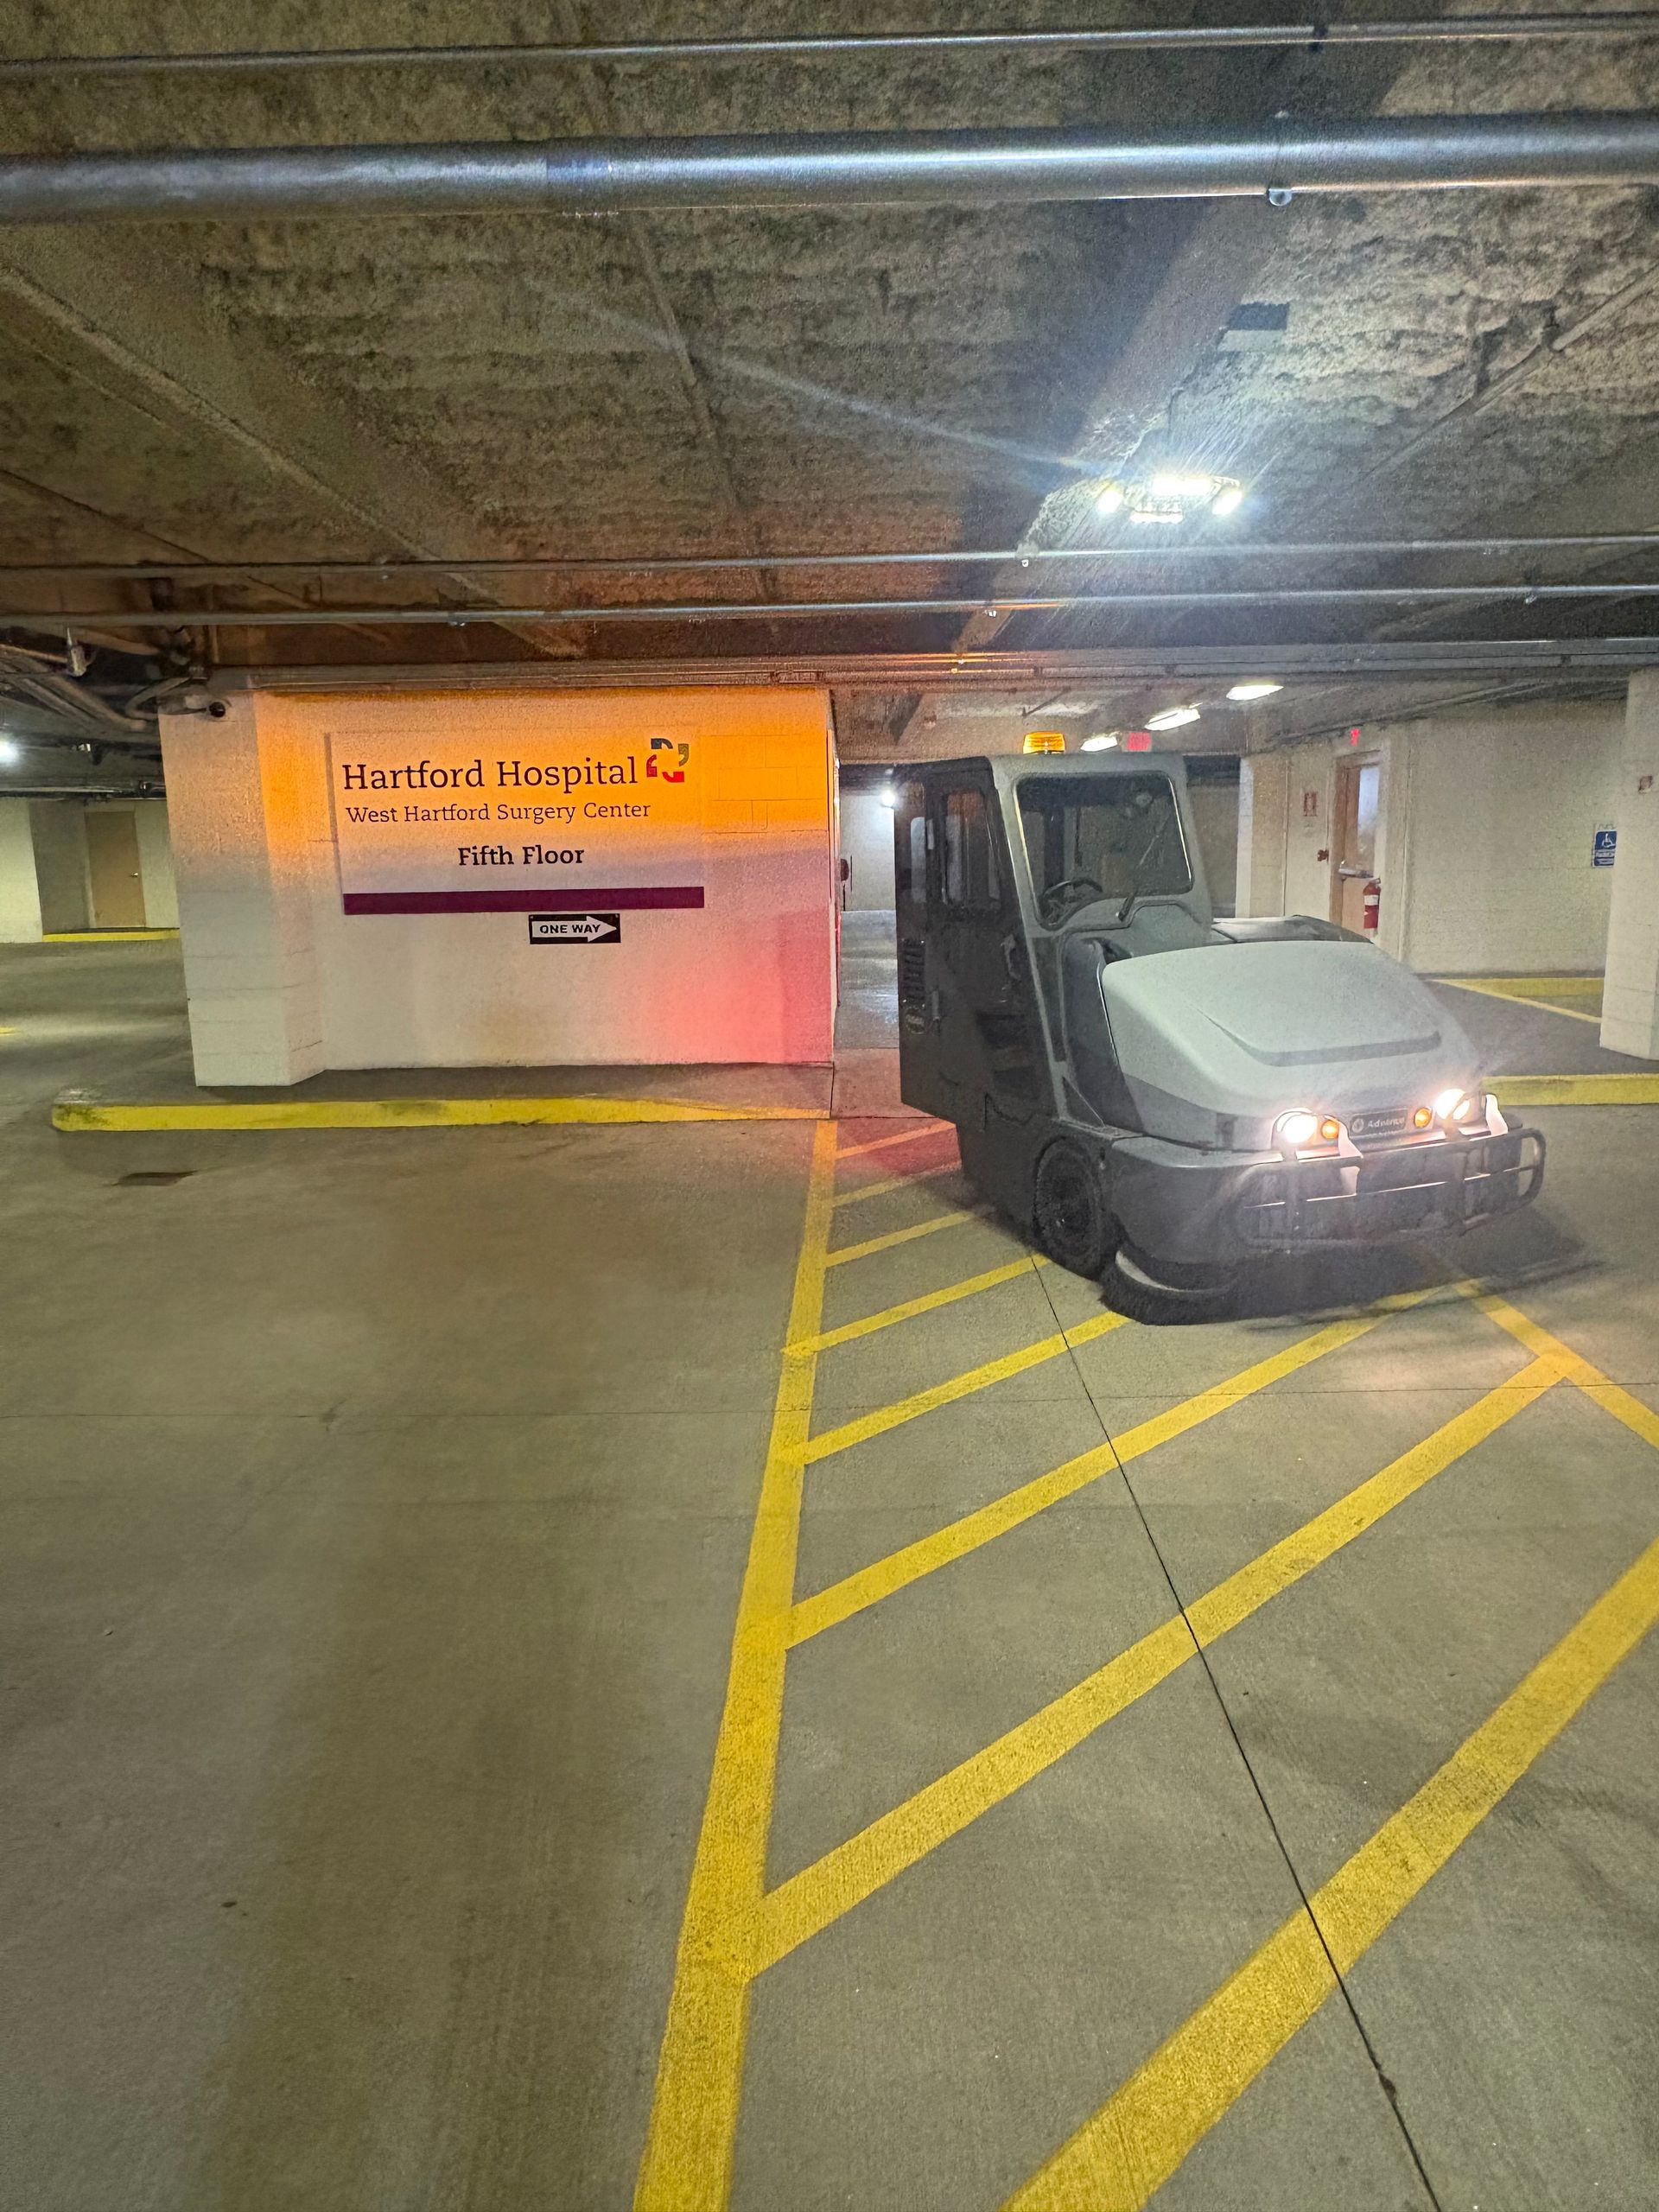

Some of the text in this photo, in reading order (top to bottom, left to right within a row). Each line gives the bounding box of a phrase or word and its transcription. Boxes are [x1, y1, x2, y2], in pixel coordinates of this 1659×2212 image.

[342, 756, 638, 793] Hartford Hospital
[346, 801, 651, 824] West Hartford Surgery Center
[457, 844, 585, 866] Fifth Floor
[539, 924, 601, 934] ONE WAY
